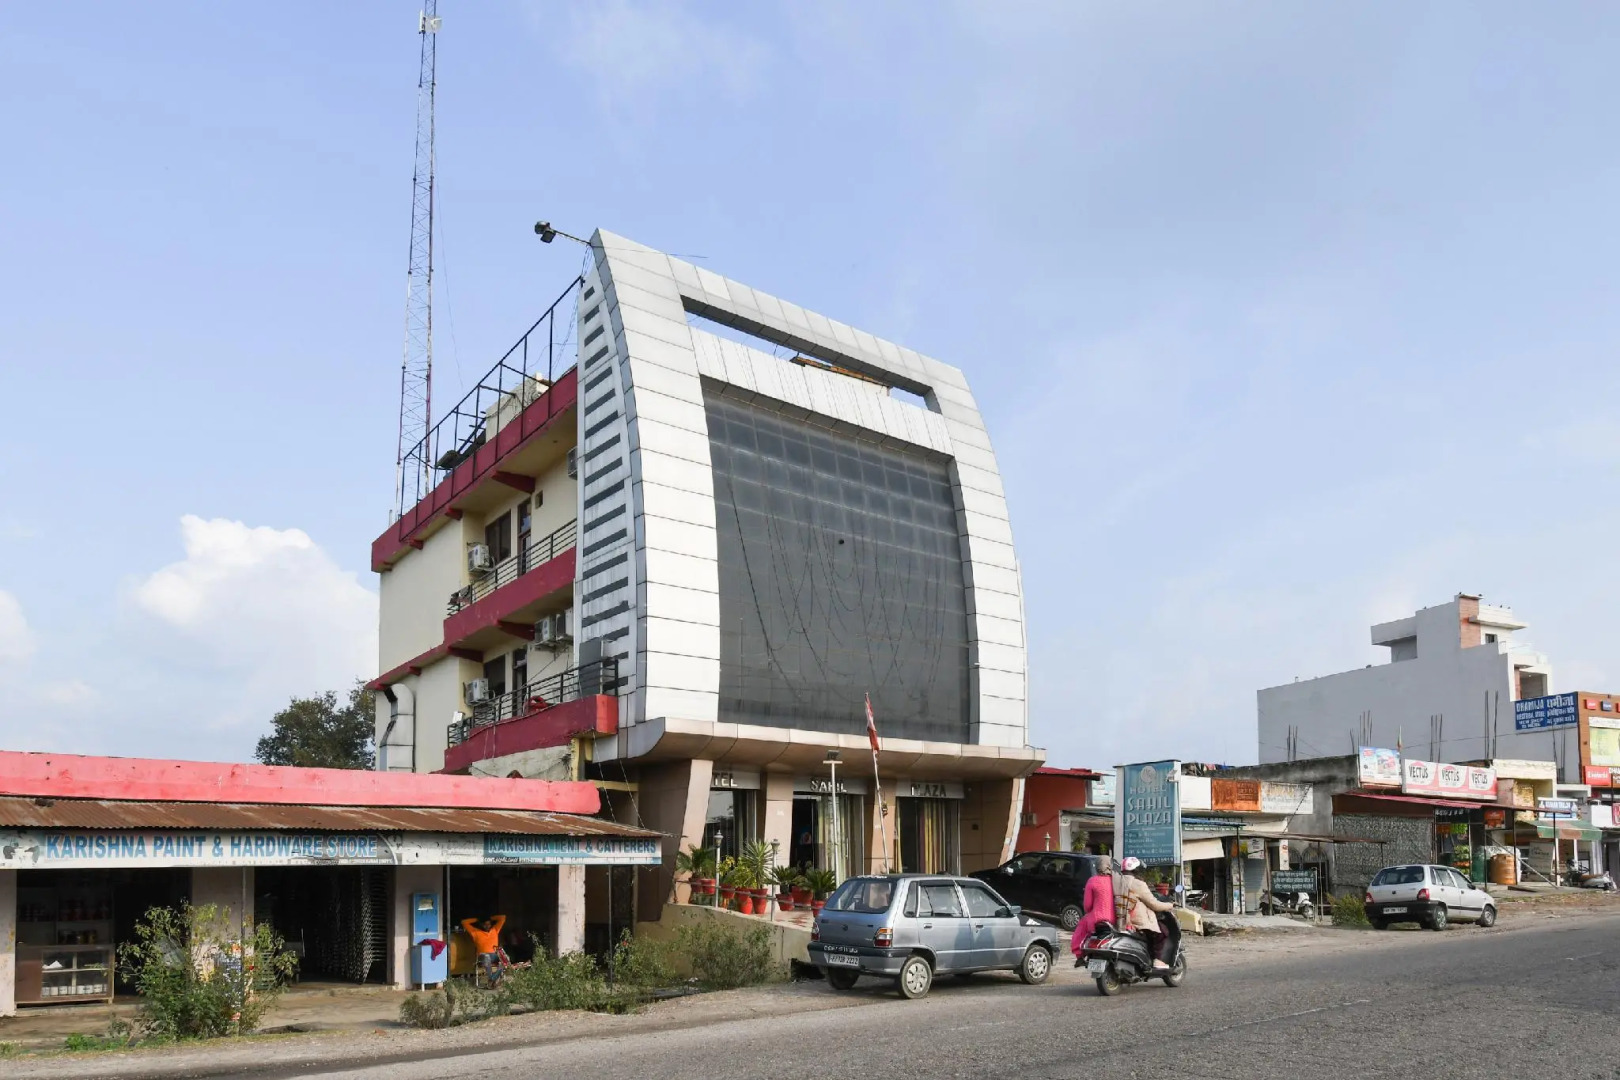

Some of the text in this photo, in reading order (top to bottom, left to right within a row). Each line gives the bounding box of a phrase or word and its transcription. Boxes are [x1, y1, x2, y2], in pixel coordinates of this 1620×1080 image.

[1408, 765, 1429, 779] VECTUS
[1441, 769, 1460, 782] VECTUS
[1471, 772, 1488, 785] VECTUS
[714, 773, 738, 787] TEL
[809, 778, 847, 793] SAHIL
[911, 783, 947, 797] PLAZA
[1129, 784, 1167, 795] HOTEL
[1127, 796, 1173, 811] SAHIL
[1126, 811, 1173, 826] PLAZA
[46, 834, 378, 859] KARISHNA PAINT & HARDWARE STORE
[488, 836, 657, 854] KARISHNA TENT & CATTERERS
